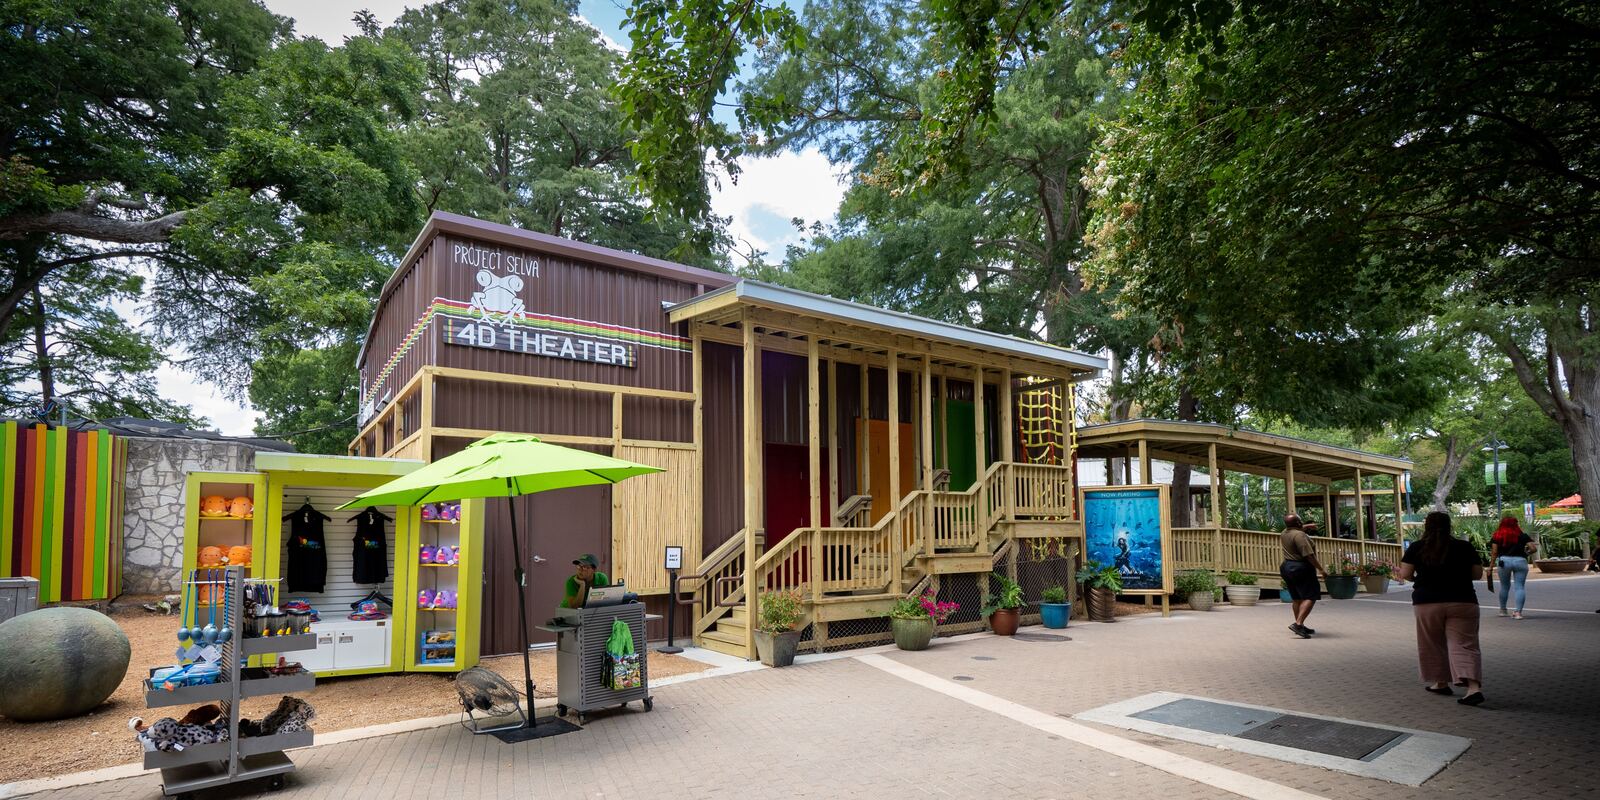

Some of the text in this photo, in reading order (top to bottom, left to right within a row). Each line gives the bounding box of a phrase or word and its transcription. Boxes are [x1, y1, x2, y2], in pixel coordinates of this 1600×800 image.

[454, 245, 539, 278] PROJECT SELVA
[456, 323, 627, 366] 4D THEATER
